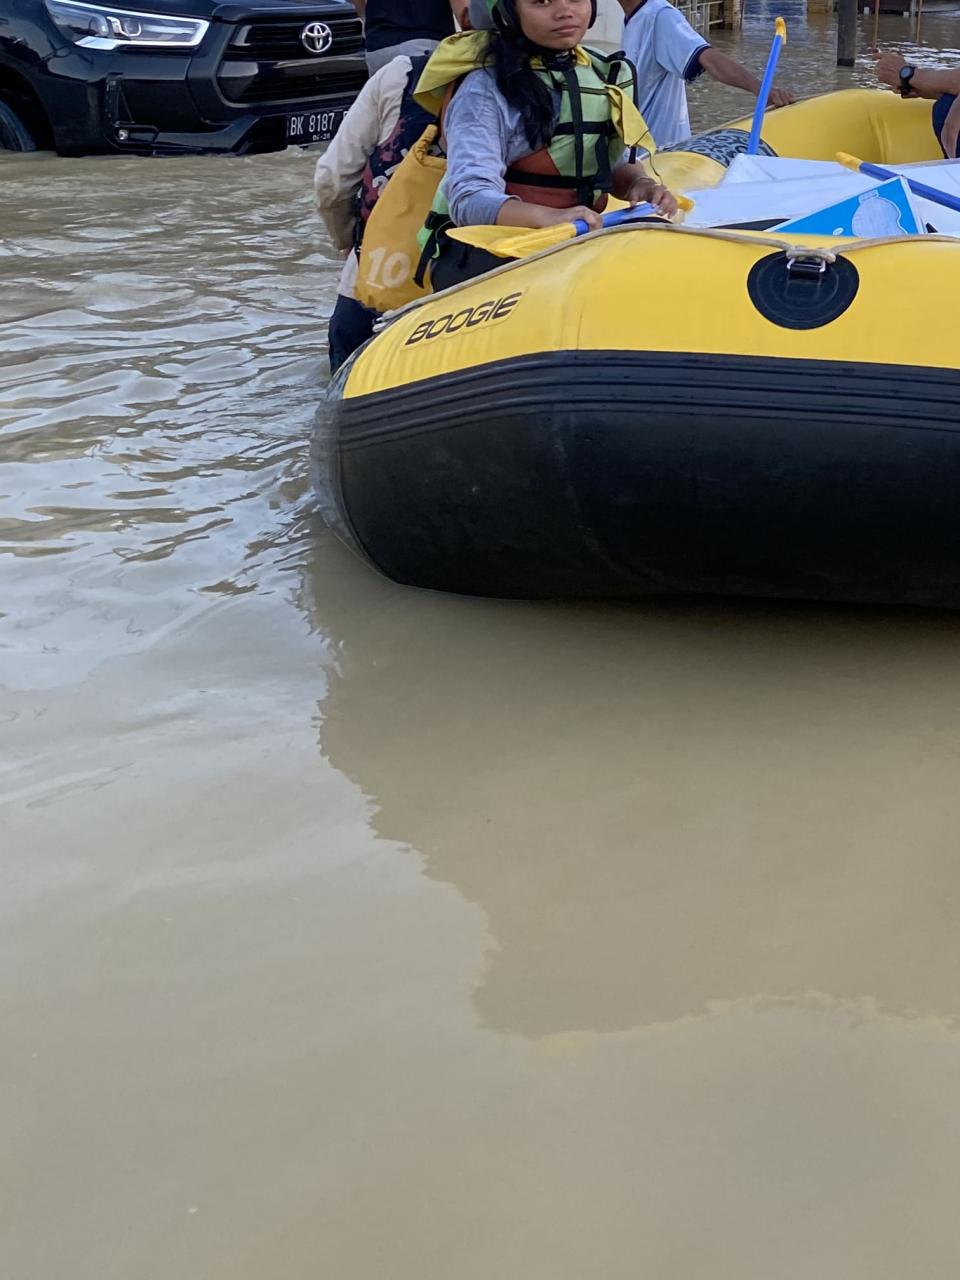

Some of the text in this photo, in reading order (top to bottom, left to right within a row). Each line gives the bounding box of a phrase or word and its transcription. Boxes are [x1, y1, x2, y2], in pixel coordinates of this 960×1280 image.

[290, 112, 335, 136] BK 8187
[366, 246, 411, 289] 10
[405, 292, 523, 346] BOOGIE
